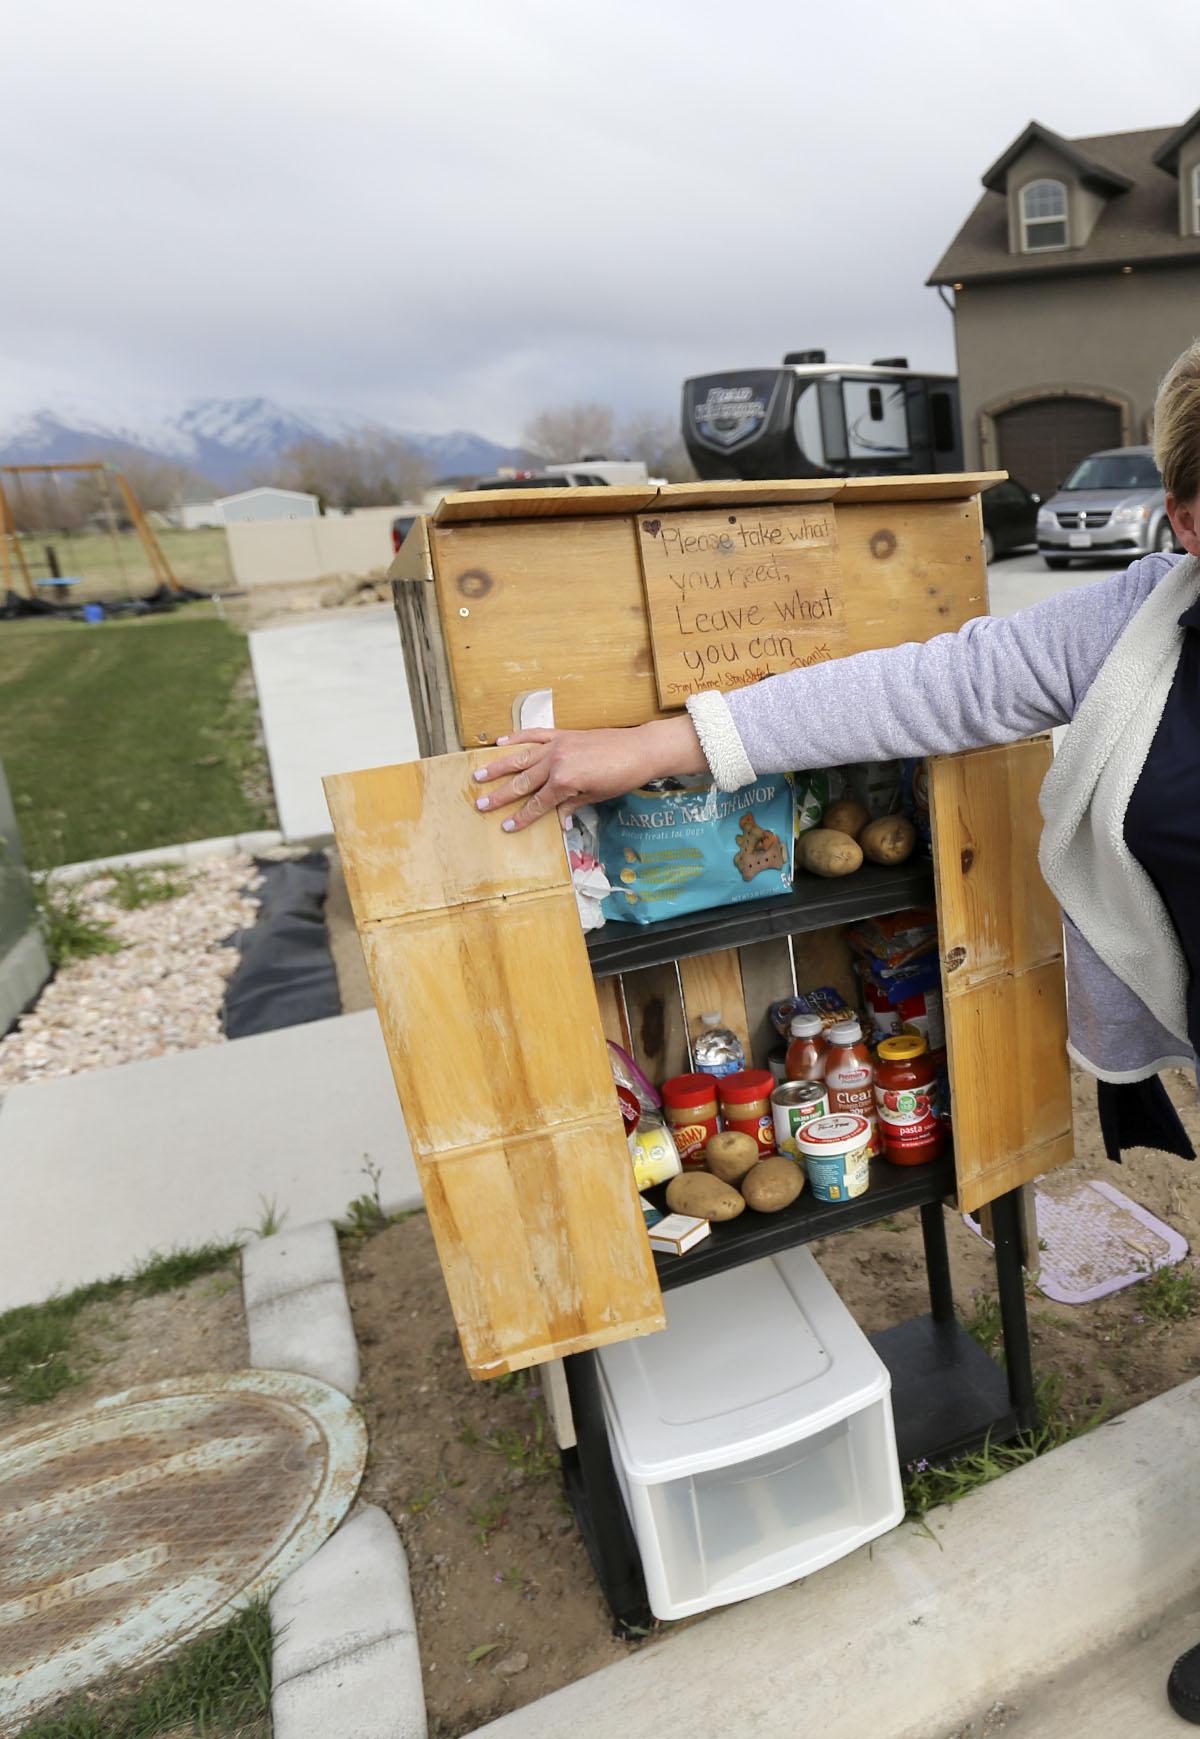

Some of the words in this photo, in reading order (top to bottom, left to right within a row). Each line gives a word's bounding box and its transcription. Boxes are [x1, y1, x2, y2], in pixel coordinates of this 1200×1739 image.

[660, 527, 733, 557] Please
[738, 523, 784, 548] take
[787, 518, 831, 541] what
[669, 571, 721, 602] you
[676, 604, 765, 635] Leave
[683, 642, 739, 680] you
[749, 636, 794, 659] can
[618, 809, 675, 829] LARGE
[836, 1090, 872, 1104] Clear
[900, 1126, 922, 1136] pasta
